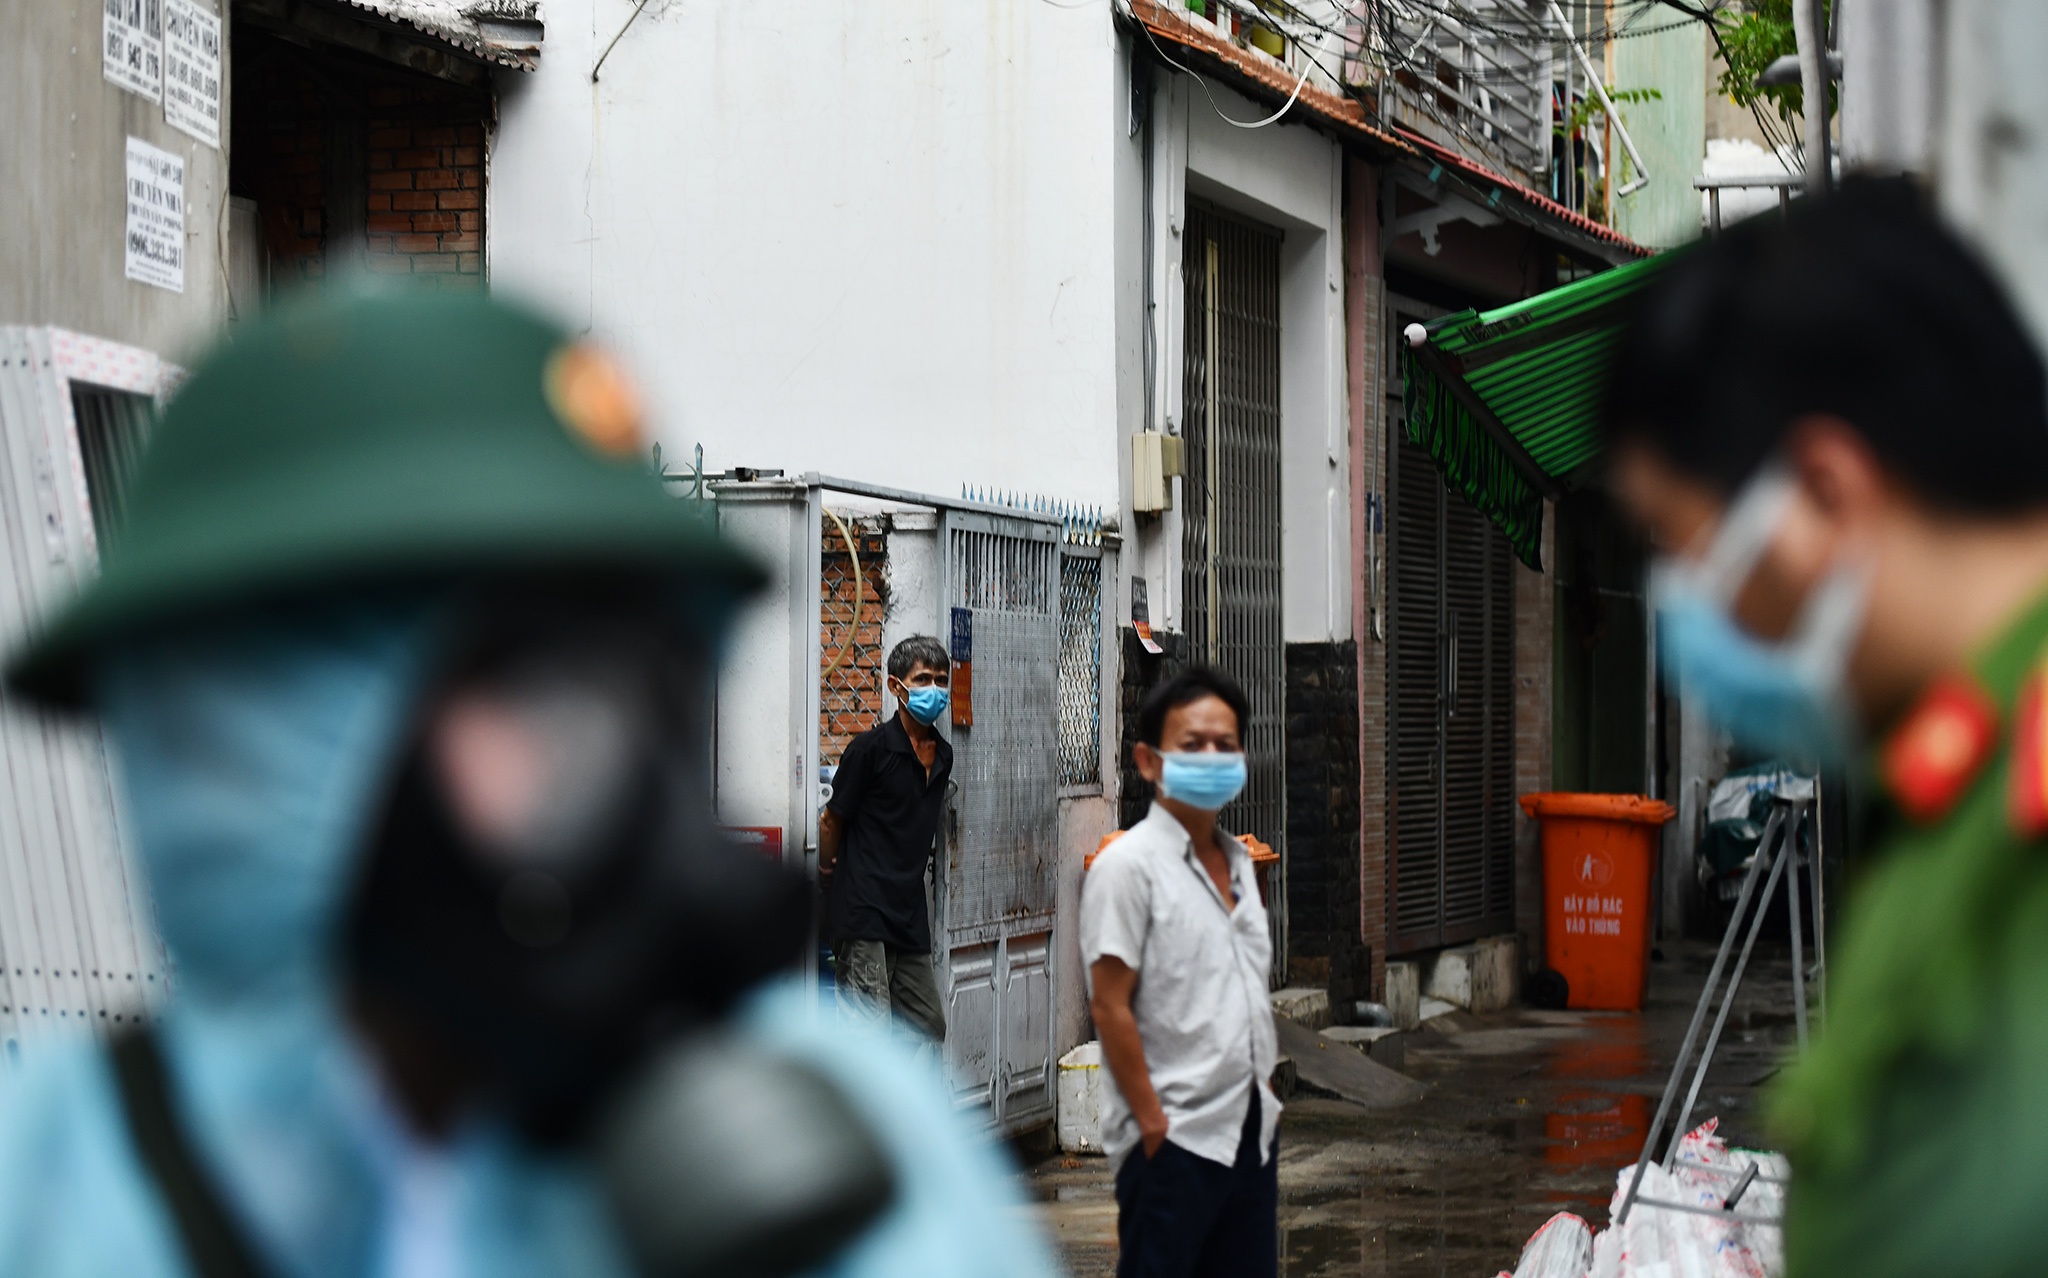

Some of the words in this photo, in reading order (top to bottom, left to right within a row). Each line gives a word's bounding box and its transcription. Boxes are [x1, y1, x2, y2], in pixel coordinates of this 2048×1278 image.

[129, 176, 162, 206] CHUYỂN
[165, 190, 181, 214] NHÀ
[1565, 913, 1586, 934] VÀO
[1589, 914, 1621, 936] THÙNG
